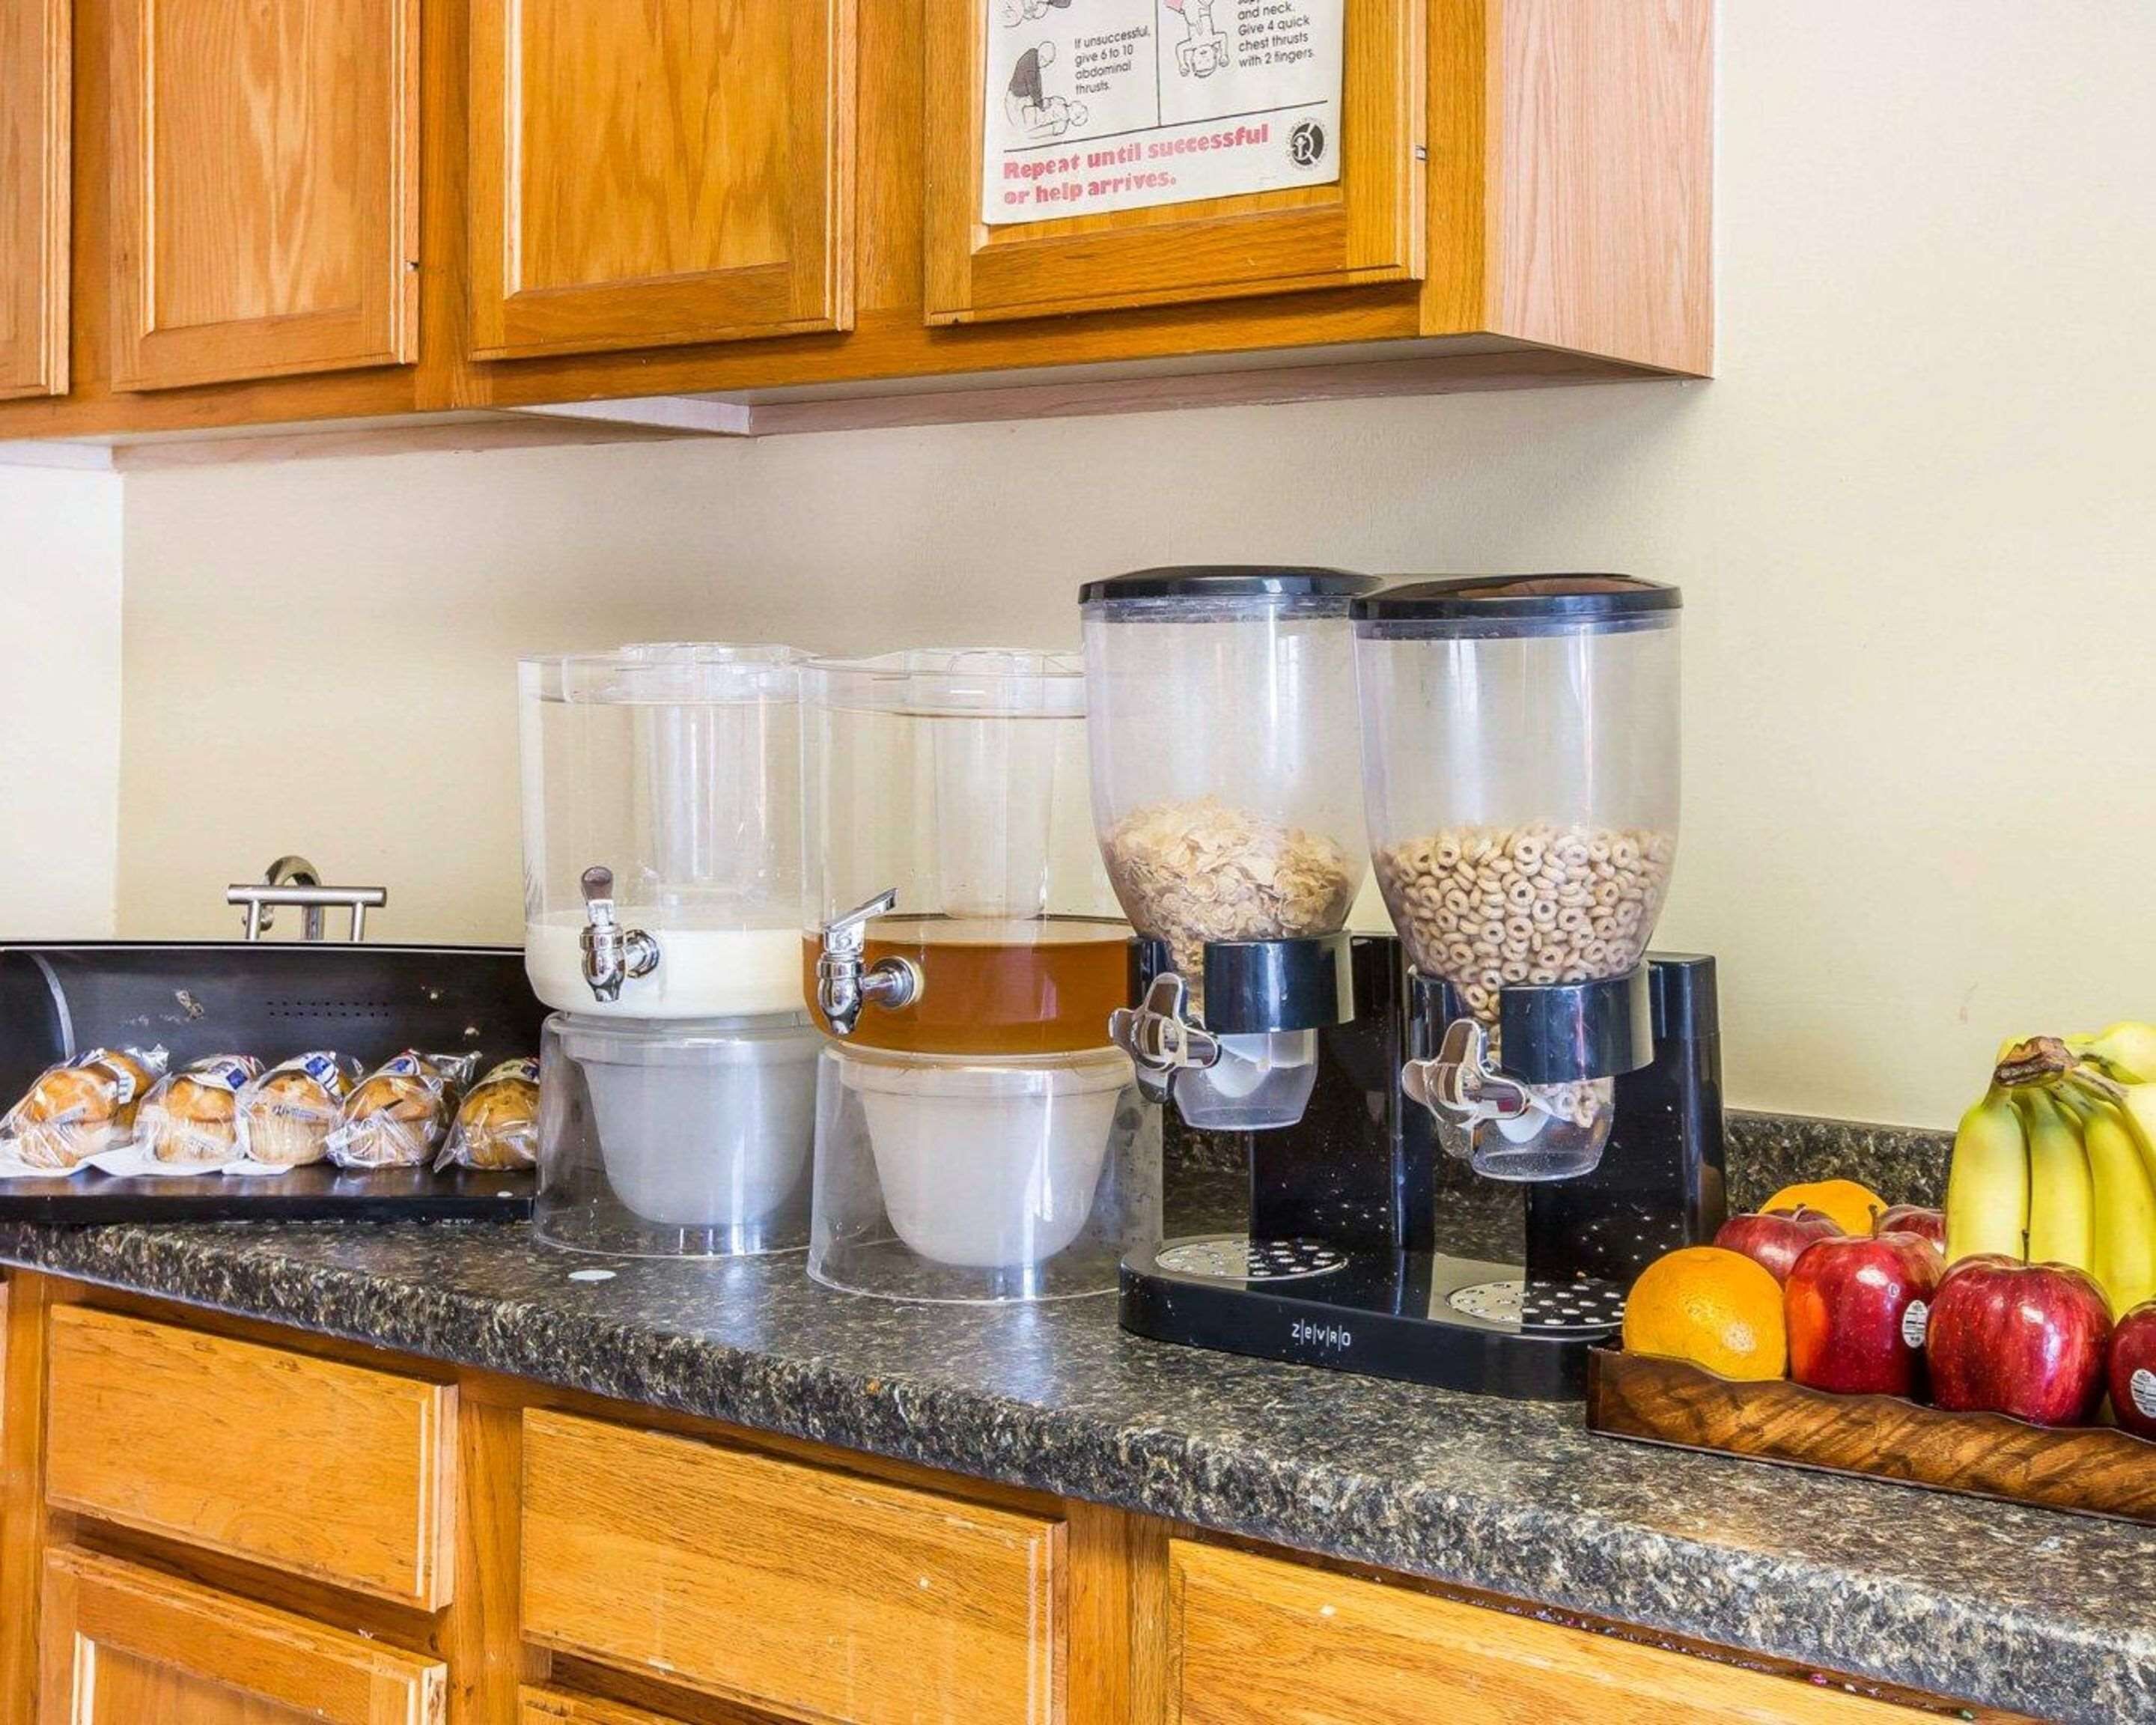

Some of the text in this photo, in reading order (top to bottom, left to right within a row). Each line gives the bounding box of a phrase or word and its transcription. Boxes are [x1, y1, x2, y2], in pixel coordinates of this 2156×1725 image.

[1237, 6, 1259, 20] and
[1238, 15, 1310, 36] Give 4 quick
[1074, 37, 1081, 49] If
[1238, 31, 1309, 52] chest thrusts
[1075, 44, 1133, 67] give 6 to 10
[1239, 55, 1261, 67] with
[1264, 52, 1271, 64] 2
[1075, 61, 1131, 79] abdominal
[1004, 153, 1080, 180] Repeat
[1087, 142, 1141, 168] until
[1148, 124, 1269, 159] successful
[1005, 171, 1176, 204] or help arrives.
